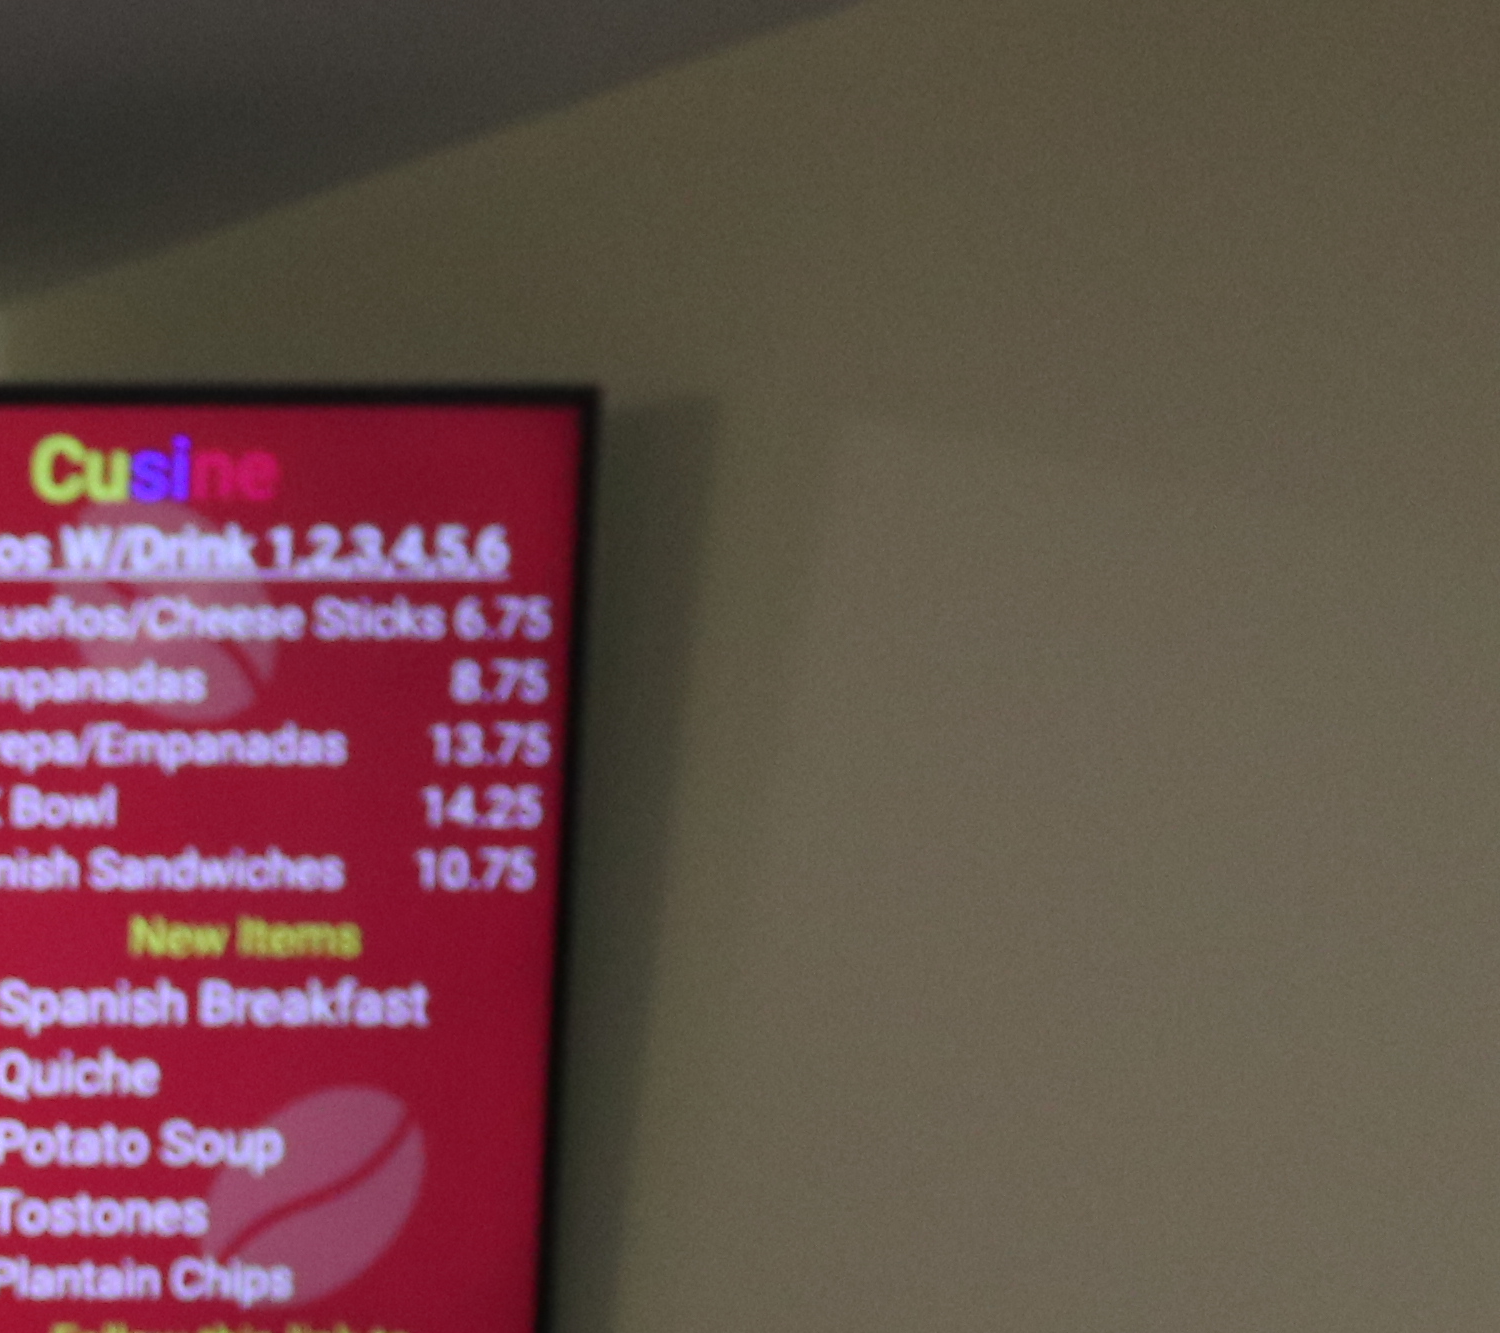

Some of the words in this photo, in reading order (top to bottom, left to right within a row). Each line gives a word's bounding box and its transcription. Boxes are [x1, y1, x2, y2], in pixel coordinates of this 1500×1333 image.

[30, 433, 279, 503] Cusine
[58, 522, 255, 578] W/Drink
[312, 594, 444, 641] Sticks
[454, 596, 553, 641] 6.75
[450, 658, 549, 704] 8.75
[428, 721, 551, 767] 13.75
[10, 784, 118, 829] Bowl
[420, 784, 544, 830] 14.25
[87, 845, 345, 892] Sandwiches
[416, 846, 537, 890] 10.75
[127, 913, 229, 959] New
[235, 914, 362, 959] Items
[197, 976, 430, 1027] Breakfast
[158, 1118, 285, 1176] Soup
[170, 1257, 296, 1309] Chips
